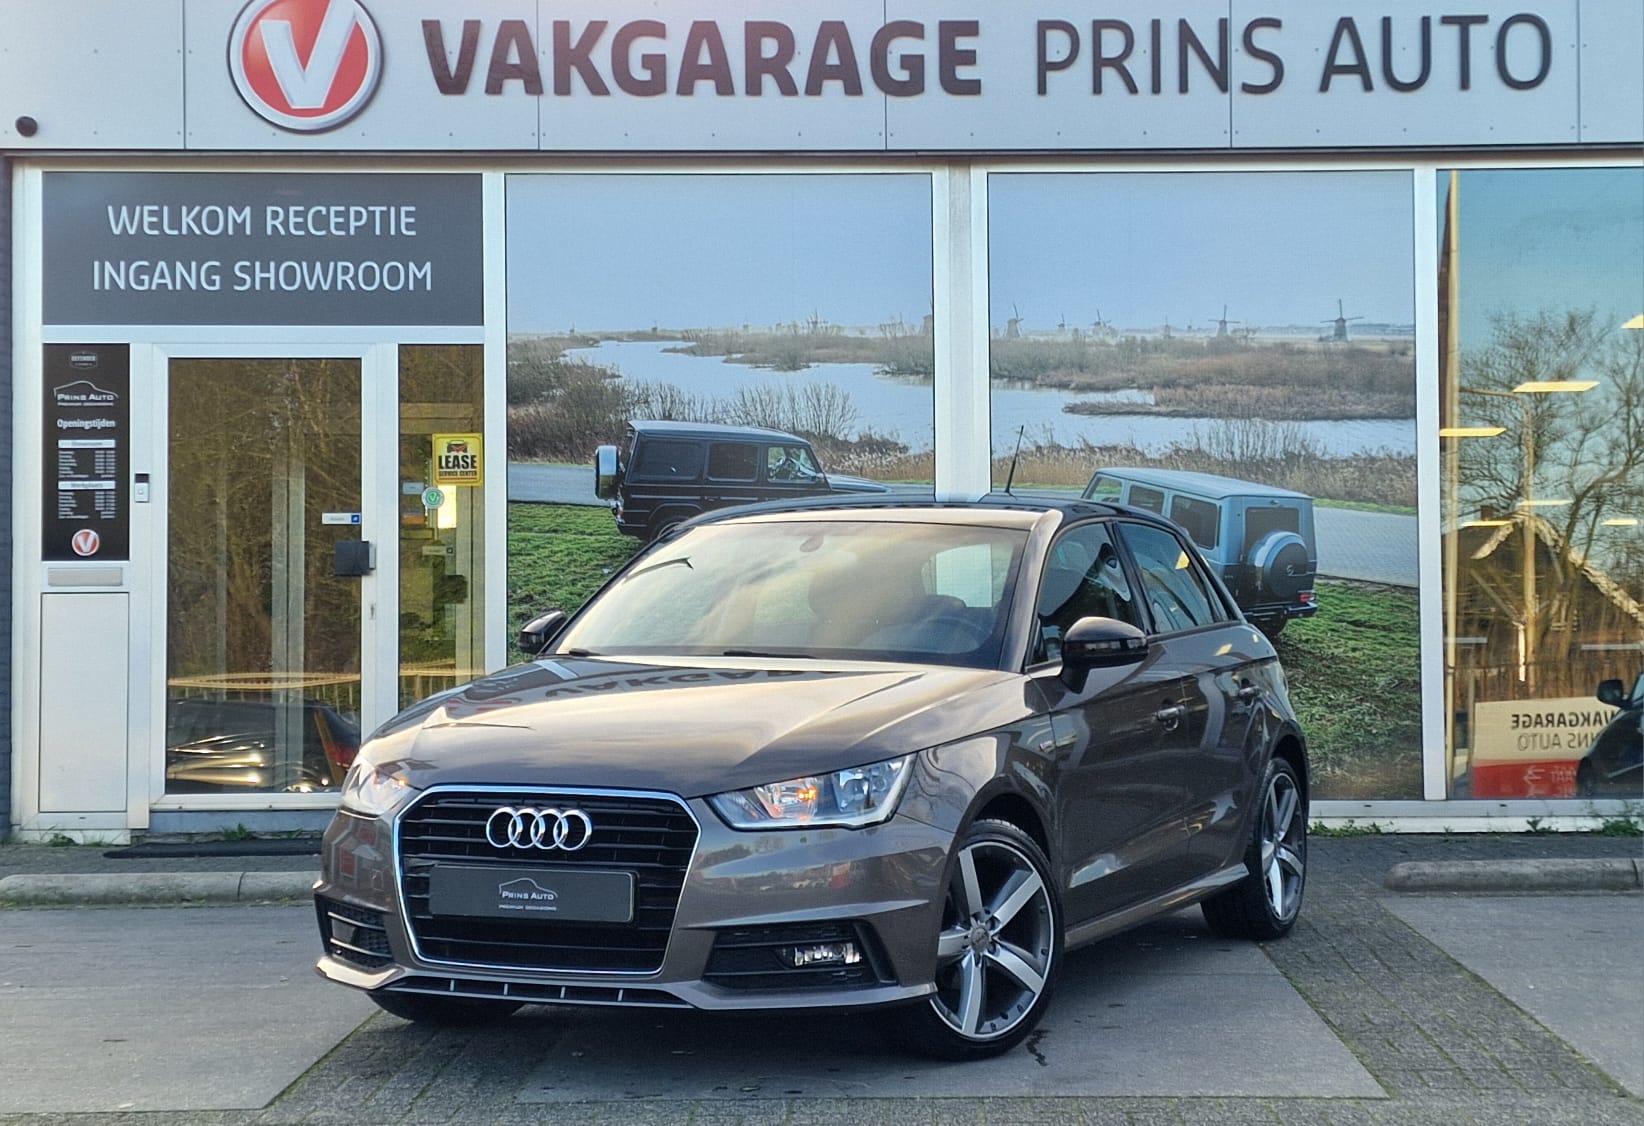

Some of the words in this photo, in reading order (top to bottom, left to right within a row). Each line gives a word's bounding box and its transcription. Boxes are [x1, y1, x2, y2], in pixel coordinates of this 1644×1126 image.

[421, 19, 982, 98] VAKGARAGE
[1037, 17, 1286, 96] PRINS
[1318, 12, 1553, 93] AUTO
[107, 204, 252, 237] WELKOM
[265, 204, 418, 237] RECEPTIE
[92, 260, 222, 292] INGANG
[233, 260, 433, 292] SHOWROOM
[57, 418, 116, 430] Openingstijden
[438, 455, 478, 470] LEASE
[531, 892, 555, 900] AUTO
